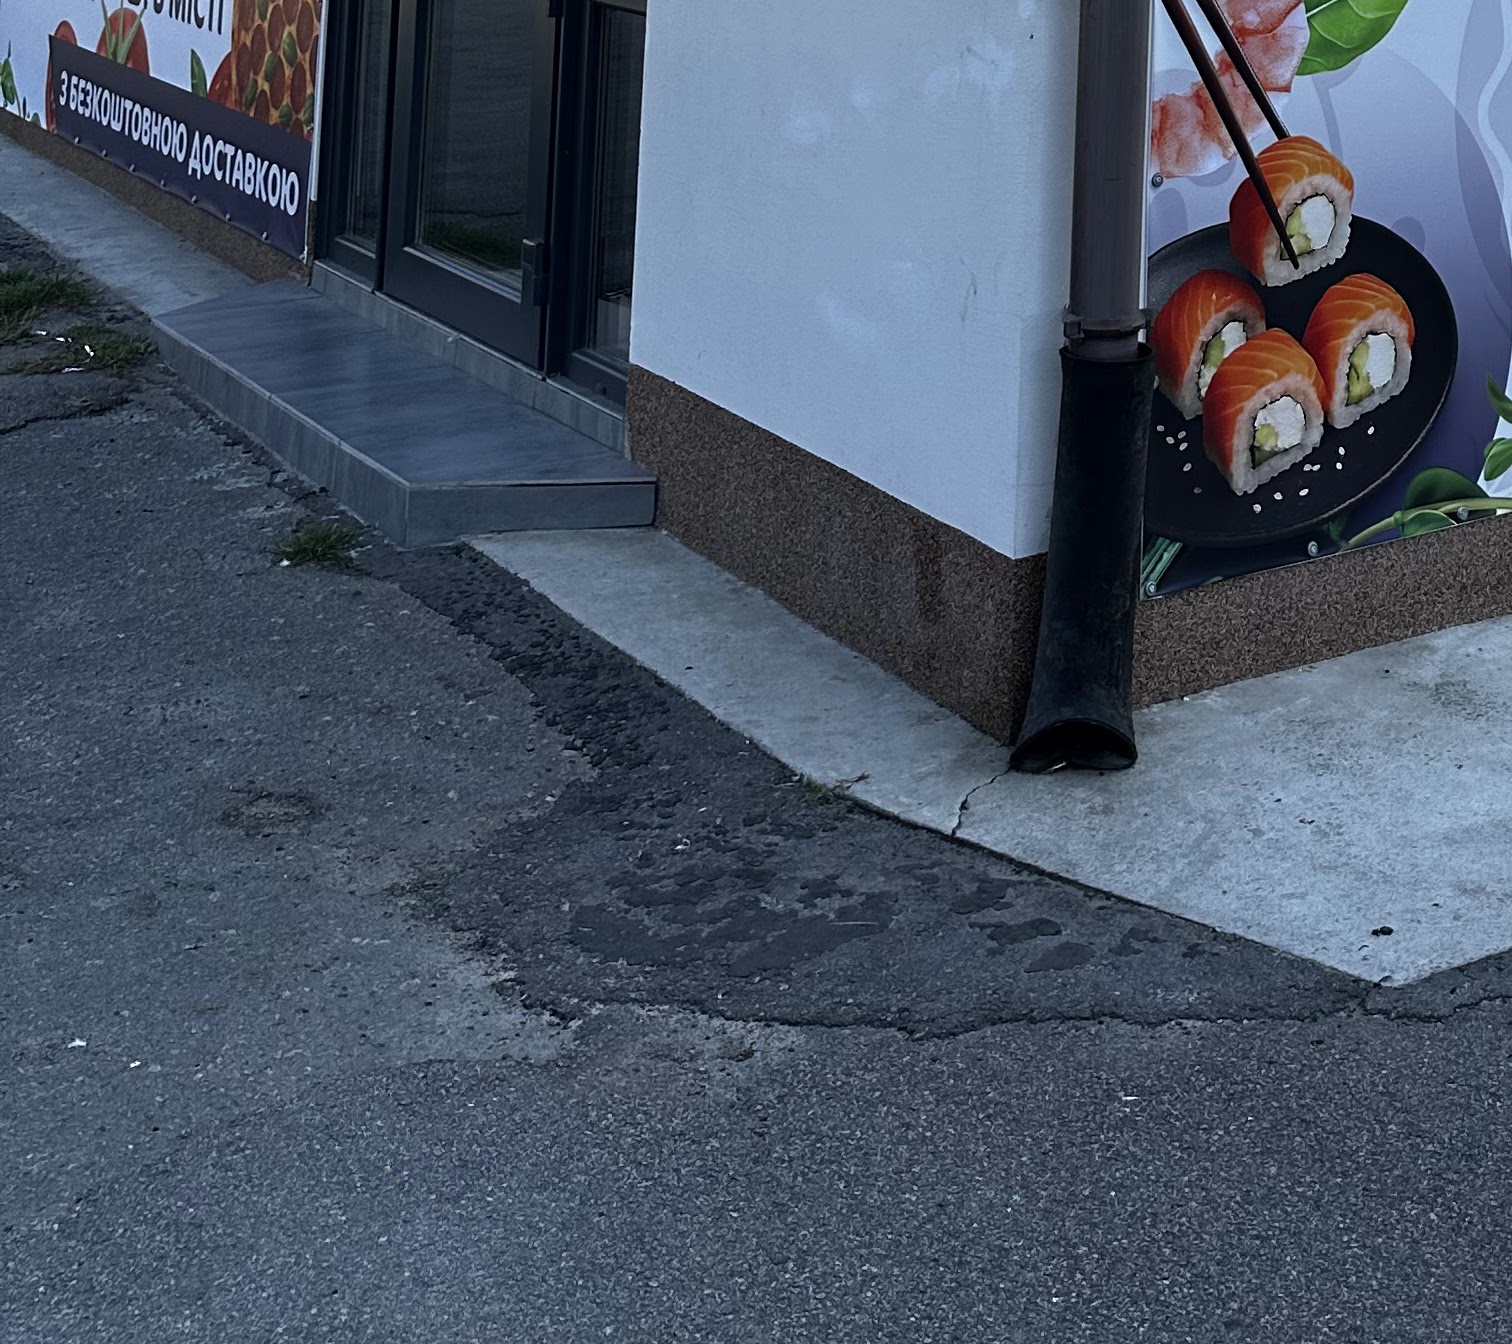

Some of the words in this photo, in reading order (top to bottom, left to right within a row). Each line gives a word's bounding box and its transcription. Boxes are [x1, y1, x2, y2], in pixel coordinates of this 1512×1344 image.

[58, 69, 68, 106] З
[69, 74, 188, 163] БЕЗКОШТОВНОЮ
[187, 133, 300, 217] ДОСТАВКОЮ
